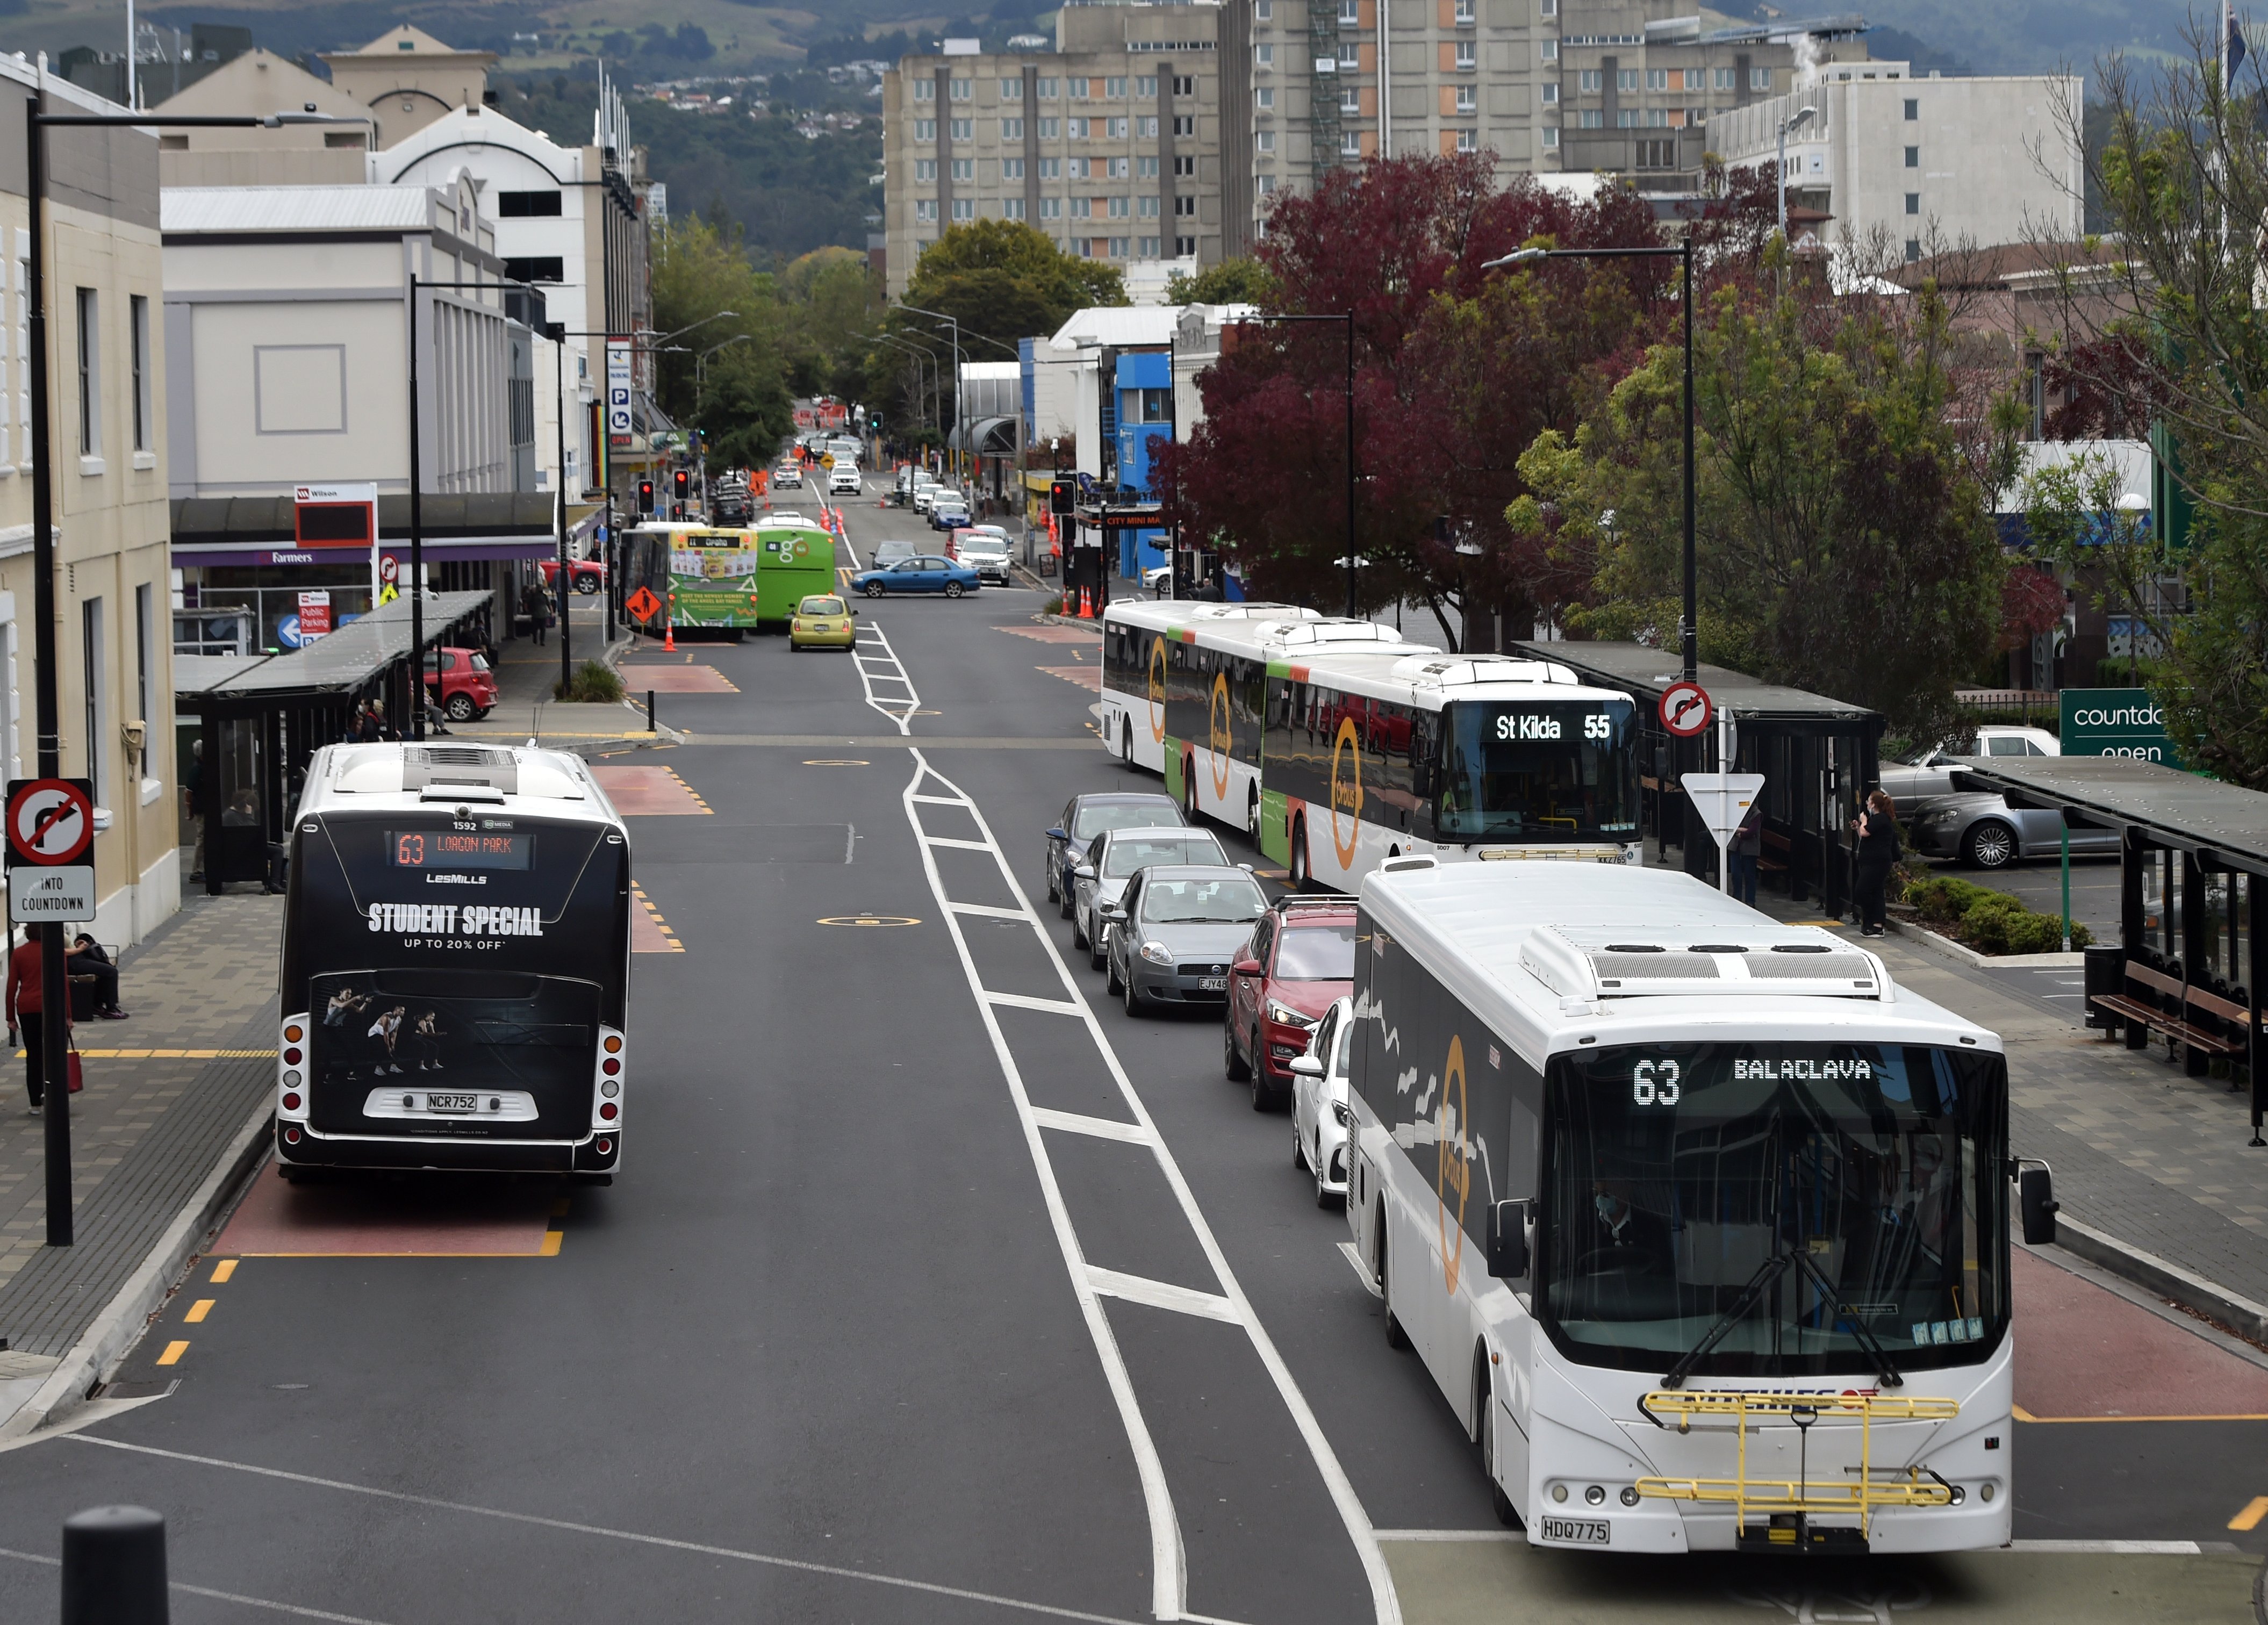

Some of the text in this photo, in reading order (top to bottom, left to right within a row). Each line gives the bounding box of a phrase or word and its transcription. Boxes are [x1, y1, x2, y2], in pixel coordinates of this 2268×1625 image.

[611, 434, 631, 444] OPEN
[1107, 517, 1125, 525] CITY
[1127, 516, 1145, 524] MINI
[272, 551, 313, 563] Farmers
[301, 607, 324, 616] Public
[301, 617, 329, 628] Parking
[1152, 679, 1164, 699] Orbus
[1497, 715, 1610, 739] St Kilda 55
[1214, 726, 1226, 751] Orbus
[1336, 780, 1355, 808] Orbus
[453, 821, 476, 831] 1592
[398, 835, 425, 865] 63
[483, 837, 512, 853] PARK
[41, 877, 63, 890] INTO
[22, 897, 83, 910] COUNTDOWN
[368, 903, 543, 936] STUDENT SPECIAL
[404, 939, 421, 947] UP
[426, 939, 442, 948] TO
[447, 940, 472, 950] 20%
[1634, 1059, 1871, 1105] 63 BALACLAVA
[429, 1095, 475, 1108] NCR752
[1444, 1140, 1460, 1194] Orbus
[1544, 1520, 1606, 1540] HDQ775
